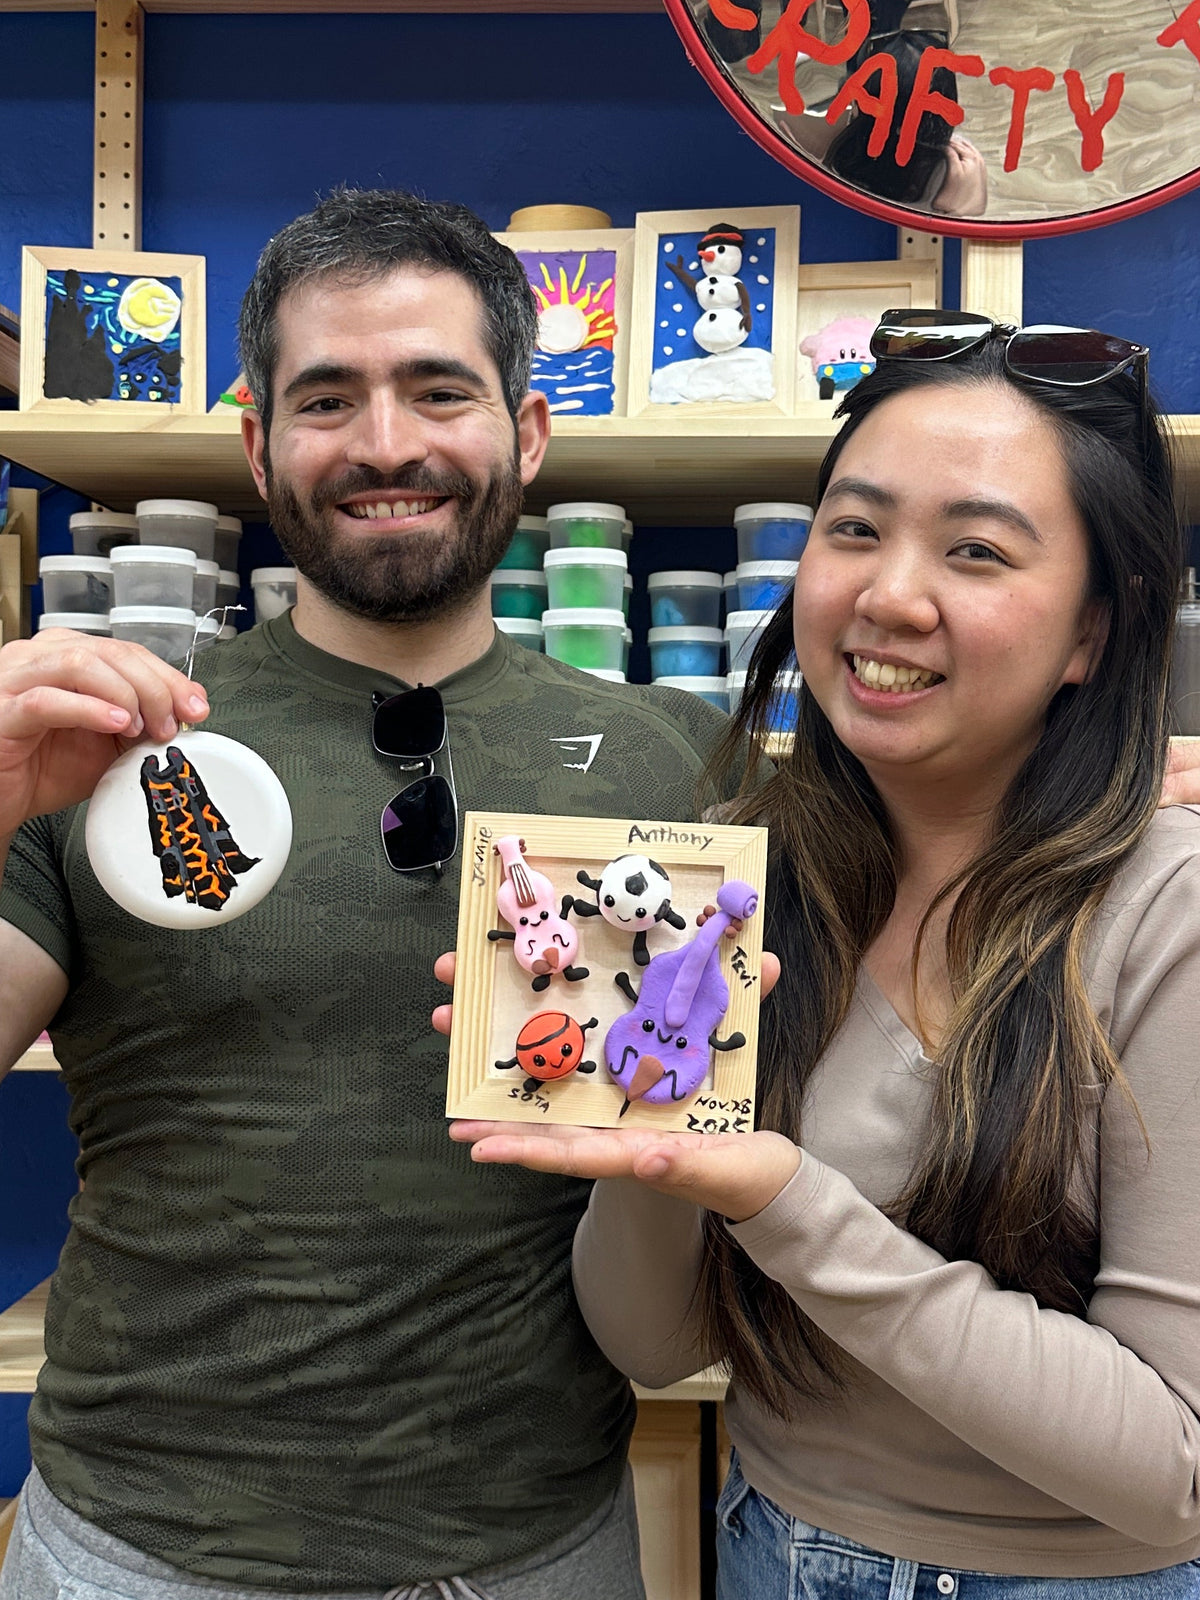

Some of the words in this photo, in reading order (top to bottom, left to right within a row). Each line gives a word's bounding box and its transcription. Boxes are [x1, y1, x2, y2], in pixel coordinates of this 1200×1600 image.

[628, 824, 714, 851] Anthony
[507, 1088, 550, 1114] SOTA
[686, 1113, 751, 1134] 2025
